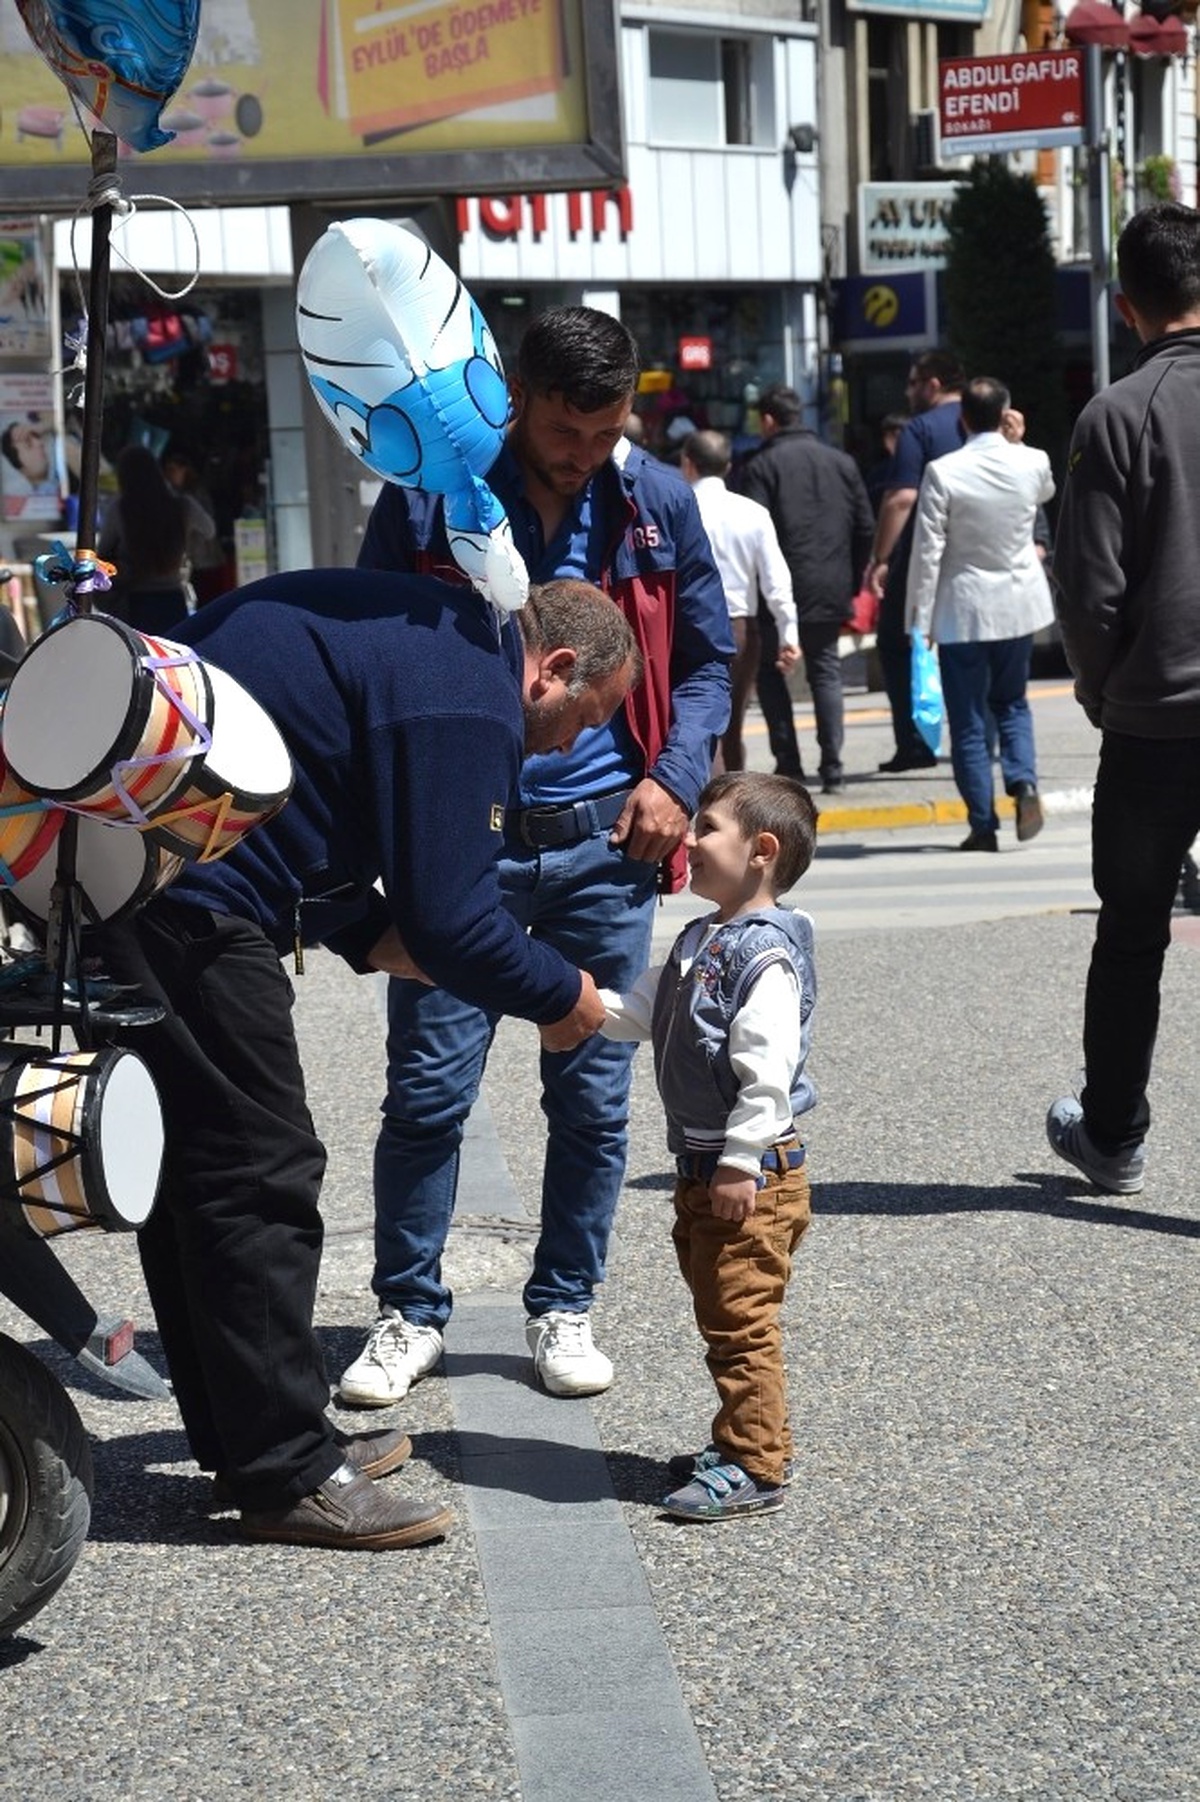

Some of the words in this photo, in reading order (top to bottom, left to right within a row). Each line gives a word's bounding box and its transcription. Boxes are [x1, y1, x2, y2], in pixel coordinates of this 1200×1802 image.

[448, 0, 541, 40] ÖDEMEYE
[425, 36, 489, 79] BAŞLA
[943, 57, 1079, 89] ABDULGAFUR
[945, 87, 1020, 117] EFENDİ
